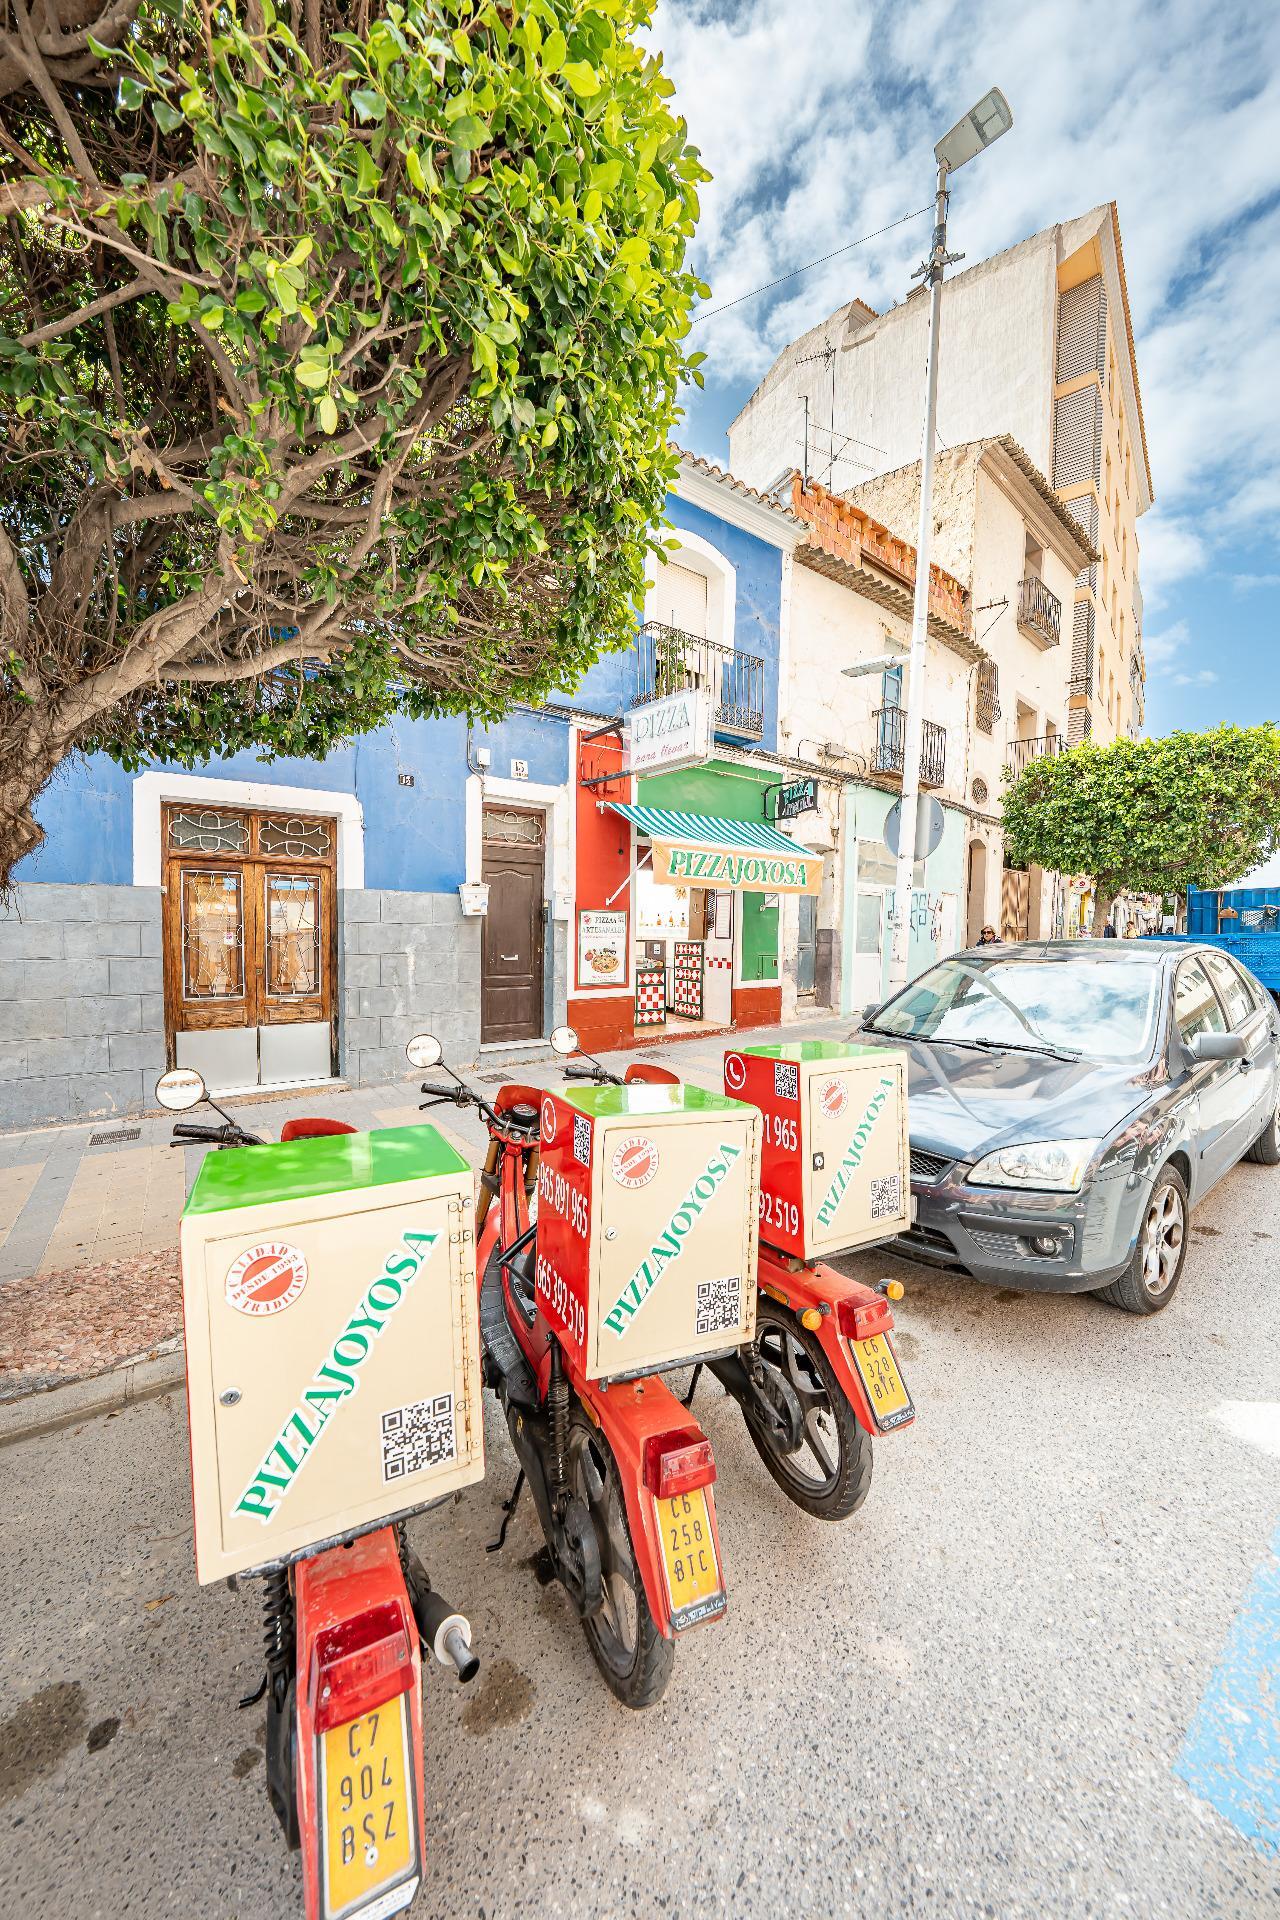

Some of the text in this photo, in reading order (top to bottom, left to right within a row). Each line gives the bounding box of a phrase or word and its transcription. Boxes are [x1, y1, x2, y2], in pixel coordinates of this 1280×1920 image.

[635, 702, 690, 742] PIZZA
[661, 741, 689, 757] llevar
[783, 781, 814, 804] PIZZA
[669, 850, 806, 885] PIZZAJOYOSA
[774, 1116, 798, 1151] 965
[816, 1078, 894, 1227] PIZZAJOYOSA
[540, 1161, 588, 1239] 965 891 965
[776, 1198, 799, 1236] 519
[602, 1144, 741, 1336] PIZZAJOYOSA
[229, 1245, 288, 1287] CALIDAD
[232, 1254, 298, 1300] DESDE 1993
[537, 1254, 585, 1346] 665 392 519
[863, 1339, 878, 1356] C6
[867, 1357, 890, 1378] 328
[236, 1231, 439, 1520] PIZZAJOYOSA
[671, 1494, 692, 1519] C6
[671, 1520, 703, 1551] 258
[675, 1550, 708, 1582] BTC
[348, 1713, 380, 1758] C7
[340, 1757, 392, 1812] 904
[341, 1801, 396, 1866] BSZ
